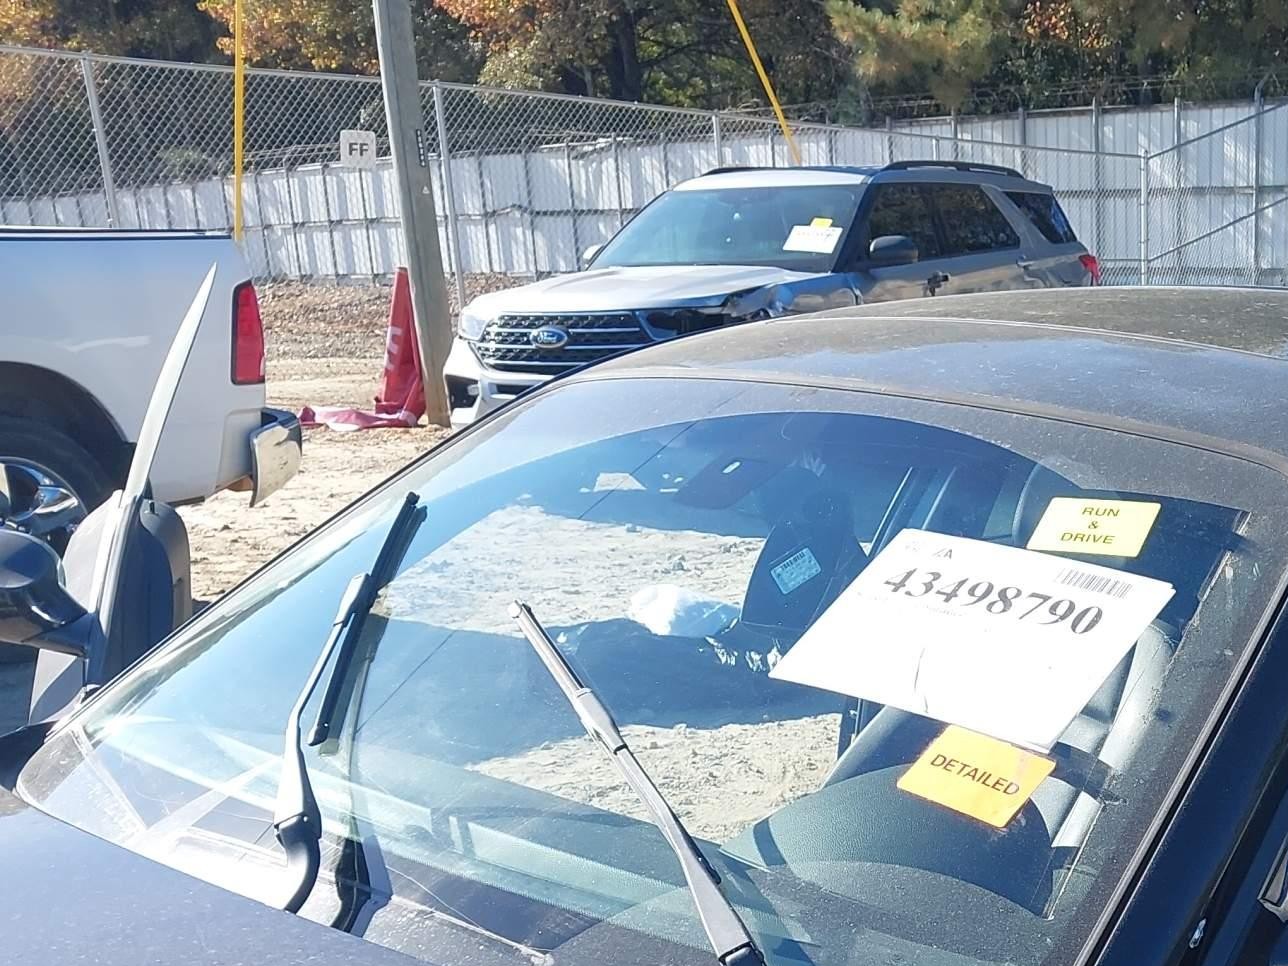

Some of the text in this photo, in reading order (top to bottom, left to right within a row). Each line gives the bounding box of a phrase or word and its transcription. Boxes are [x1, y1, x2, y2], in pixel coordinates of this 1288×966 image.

[348, 142, 369, 157] FF
[1081, 506, 1121, 517] RUN
[1087, 520, 1100, 529] &
[1060, 532, 1116, 545] DRIVE
[883, 567, 1104, 635] 43498790
[929, 753, 1021, 796] DETAILED
